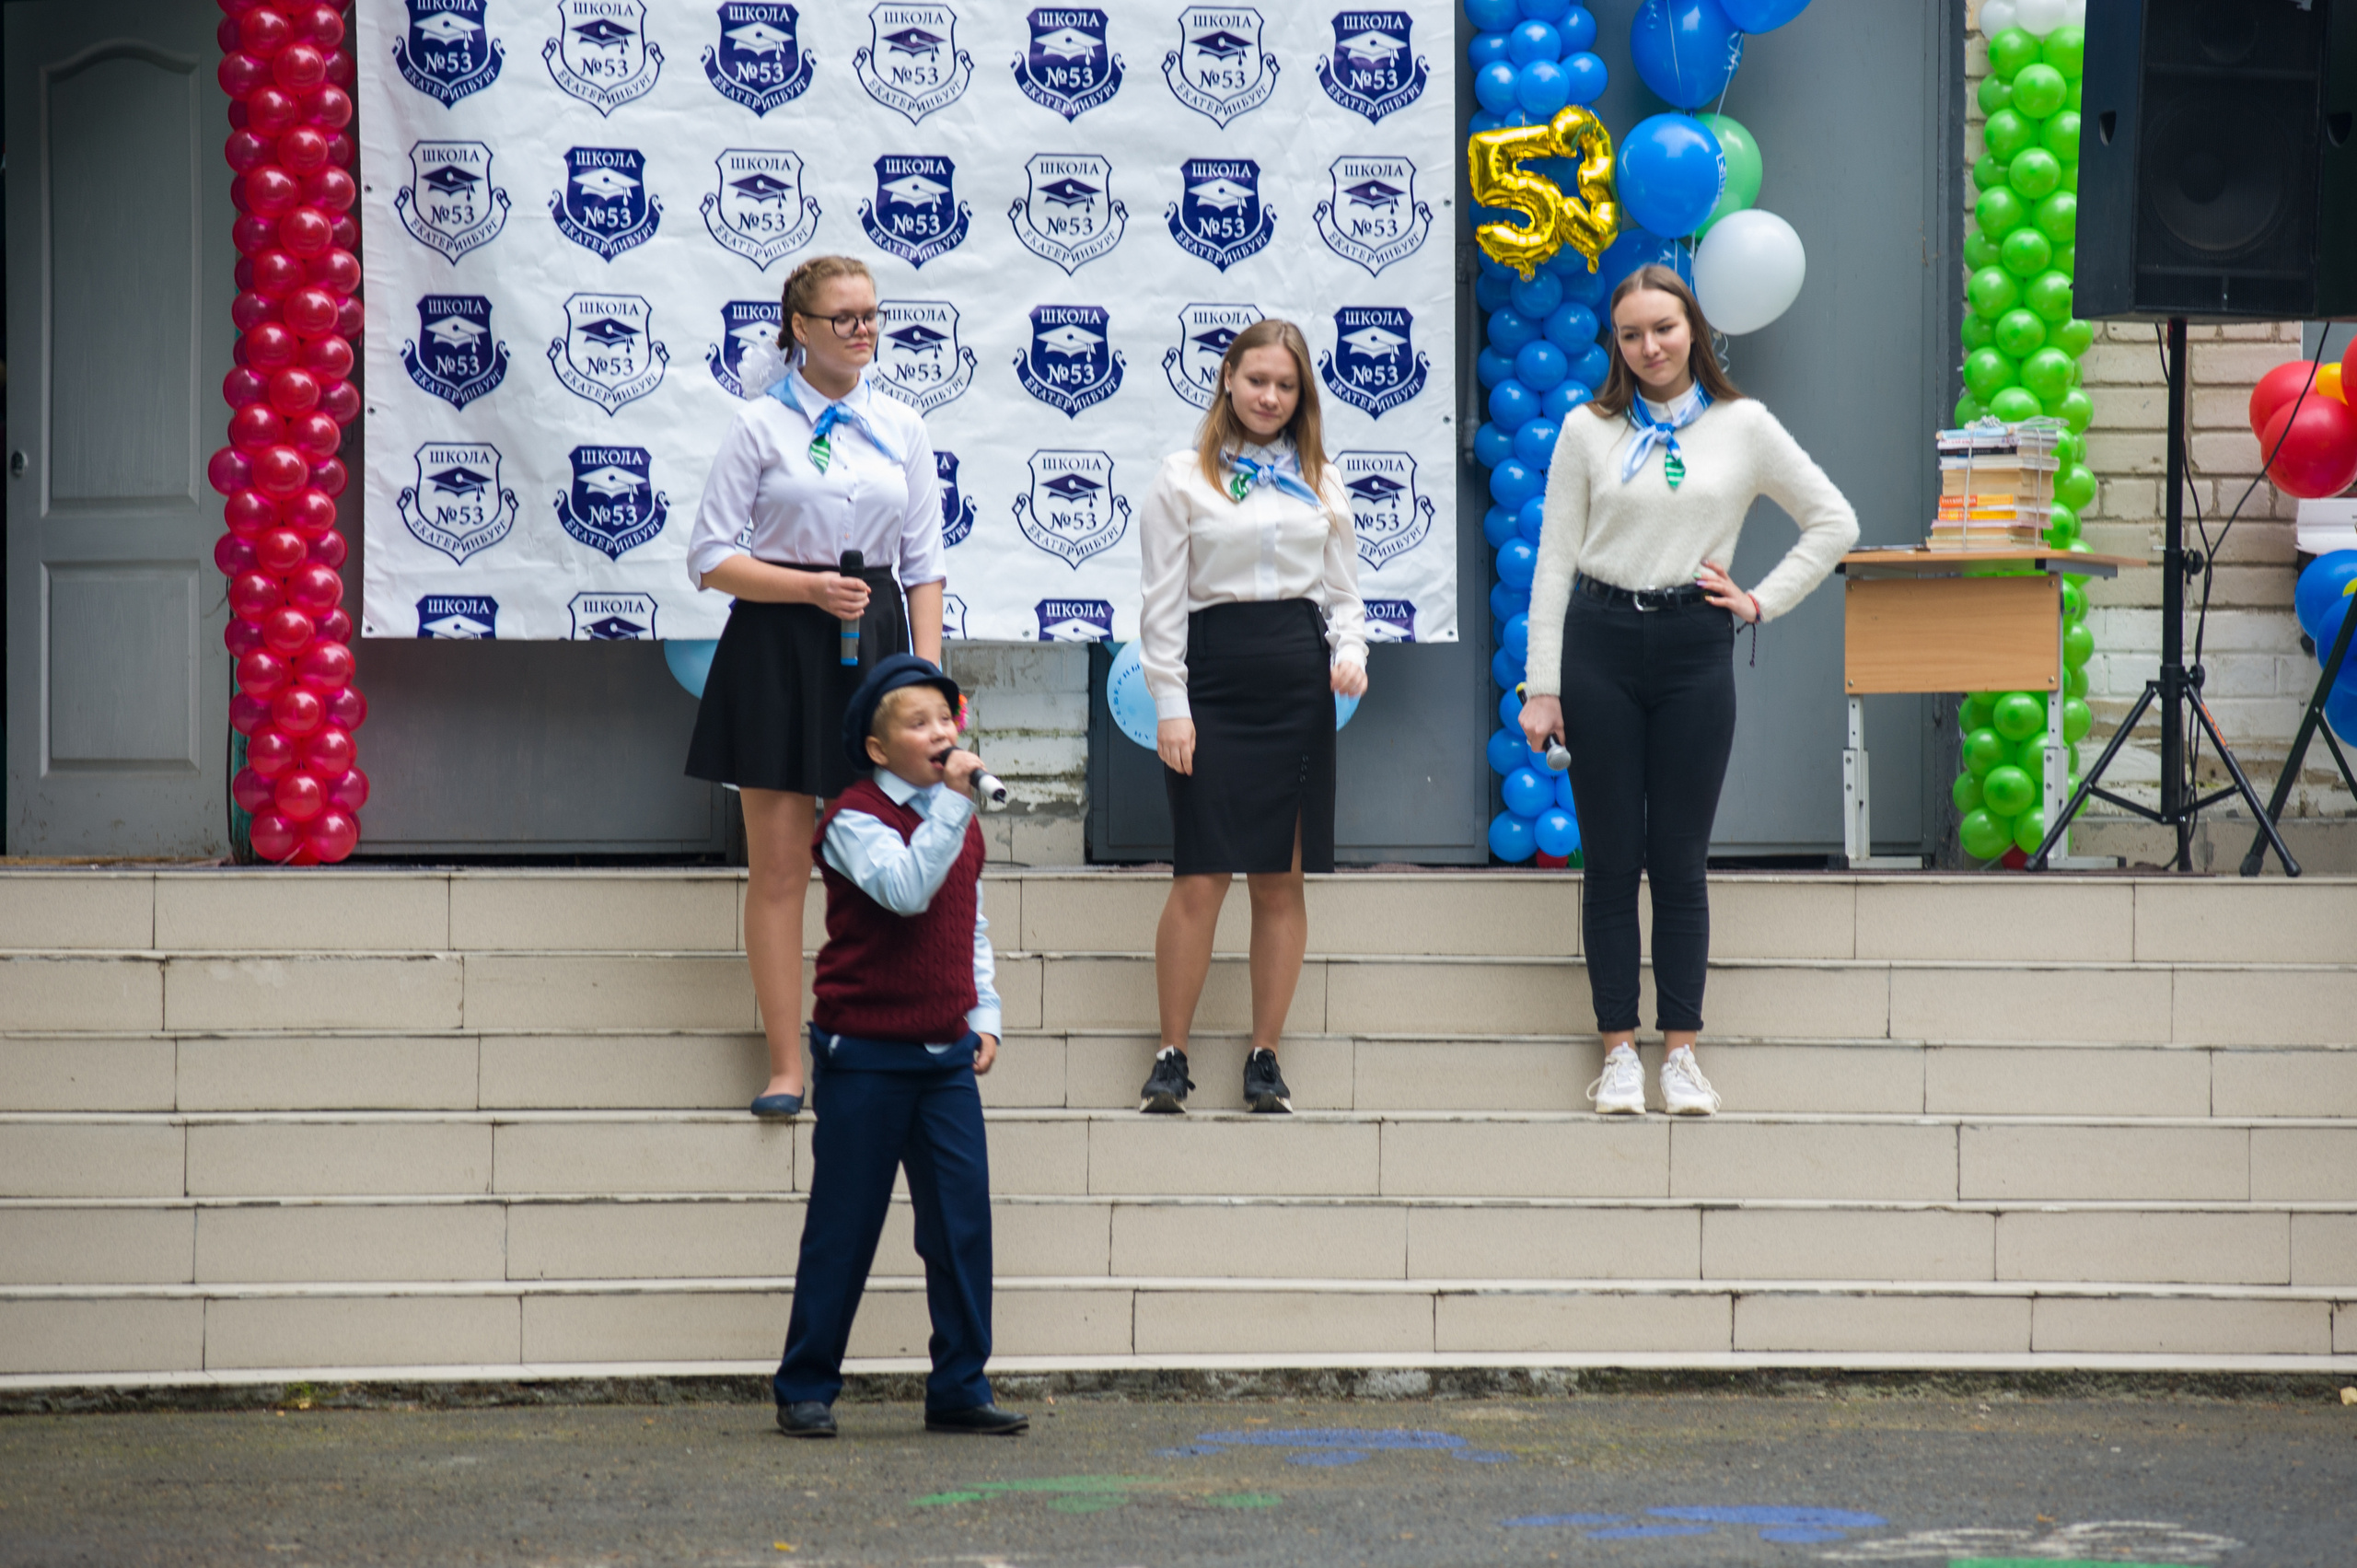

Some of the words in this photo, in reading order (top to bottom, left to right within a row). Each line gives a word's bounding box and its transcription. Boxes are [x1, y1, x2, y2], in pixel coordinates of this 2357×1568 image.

[417, 0, 478, 11] ШКОЛА
[574, 2, 633, 17] ШКОЛА
[728, 6, 790, 22] ШКОЛА
[885, 9, 943, 26] ШКОЛА
[1039, 12, 1099, 28] ШКОЛА
[1193, 14, 1252, 29] ШКОЛА
[1342, 14, 1403, 29] ШКОЛА
[424, 52, 473, 74] №53
[580, 58, 628, 77] №53
[736, 62, 784, 83] №53
[403, 65, 497, 101] ЕКАТЕРИНБУРГ
[891, 66, 939, 86] №53
[1045, 67, 1094, 87] №53
[1199, 69, 1246, 88] №53
[1350, 69, 1399, 90] №53
[557, 70, 651, 104] ЕКАТЕРИНБУРГ
[713, 75, 808, 110] ЕКАТЕРИНБУРГ
[867, 77, 961, 116] ЕКАТЕРИНБУРГ
[1023, 80, 1117, 115] ЕКАТЕРИНБУРГ
[1176, 82, 1269, 117] ЕКАТЕРИНБУРГ
[1328, 79, 1422, 117] ЕКАТЕРИНБУРГ
[423, 148, 480, 163] ШКОЛА
[575, 151, 636, 168] ШКОЛА
[730, 157, 790, 172] ШКОЛА
[886, 159, 946, 175] ШКОЛА
[1039, 161, 1099, 176] ШКОЛА
[1191, 161, 1252, 178] ШКОЛА
[1344, 163, 1403, 178] ШКОЛА
[431, 204, 474, 225] №53
[583, 207, 632, 227] №53
[737, 212, 785, 232] №53
[410, 215, 499, 254] ЕКАТЕРИНБУРГ
[892, 215, 941, 235] №53
[1046, 217, 1094, 236] №53
[1199, 217, 1246, 238] №53
[1351, 218, 1398, 237] №53
[561, 219, 655, 256] ЕКАТЕРИНБУРГ
[714, 223, 810, 261] ЕКАТЕРИНБУРГ
[869, 226, 963, 264] ЕКАТЕРИНБУРГ
[1022, 228, 1117, 264] ЕКАТЕРИНБУРГ
[1329, 230, 1422, 265] ЕКАТЕРИНБУРГ
[1177, 231, 1269, 265] ЕКАТЕРИНБУРГ
[428, 298, 483, 314] ШКОЛА
[579, 301, 639, 317] ШКОЛА
[732, 305, 782, 319] ШКОЛ
[886, 308, 946, 321] ШКОЛА
[1040, 309, 1100, 325] ШКОЛА
[1194, 312, 1253, 325] ШКОЛА
[1345, 310, 1404, 325] ШКОЛА
[435, 355, 480, 375] №53
[586, 356, 633, 376] №53
[895, 364, 942, 381] №53
[1046, 364, 1094, 384] №53
[1352, 365, 1398, 385] №53
[412, 369, 502, 402] ЕКАТЕРИНБУРГ
[563, 368, 658, 404] ЕКАТЕРИНБУРГ
[1026, 377, 1120, 411] ЕКАТЕРИНБУРГ
[1329, 377, 1422, 412] ЕКАТЕРИНБУРГ
[430, 449, 490, 465] ШКОЛА
[581, 449, 643, 466] ШКОЛА
[1043, 456, 1101, 470] ШКОЛА
[1347, 459, 1405, 471] ШКОЛА
[435, 505, 483, 526] №53
[589, 505, 638, 526] №53
[1050, 512, 1097, 529] №53
[413, 518, 505, 553] ЕКАТЕРИНБУРГ
[565, 518, 661, 553] ЕКАТЕРИНБУРГ
[1028, 523, 1120, 559] ЕКАТЕРИНБУРГ
[427, 599, 490, 615] ШКОЛА
[583, 600, 644, 615] ШКОЛА
[1045, 602, 1106, 619] ШКОЛА
[1364, 605, 1408, 618] КОЛА
